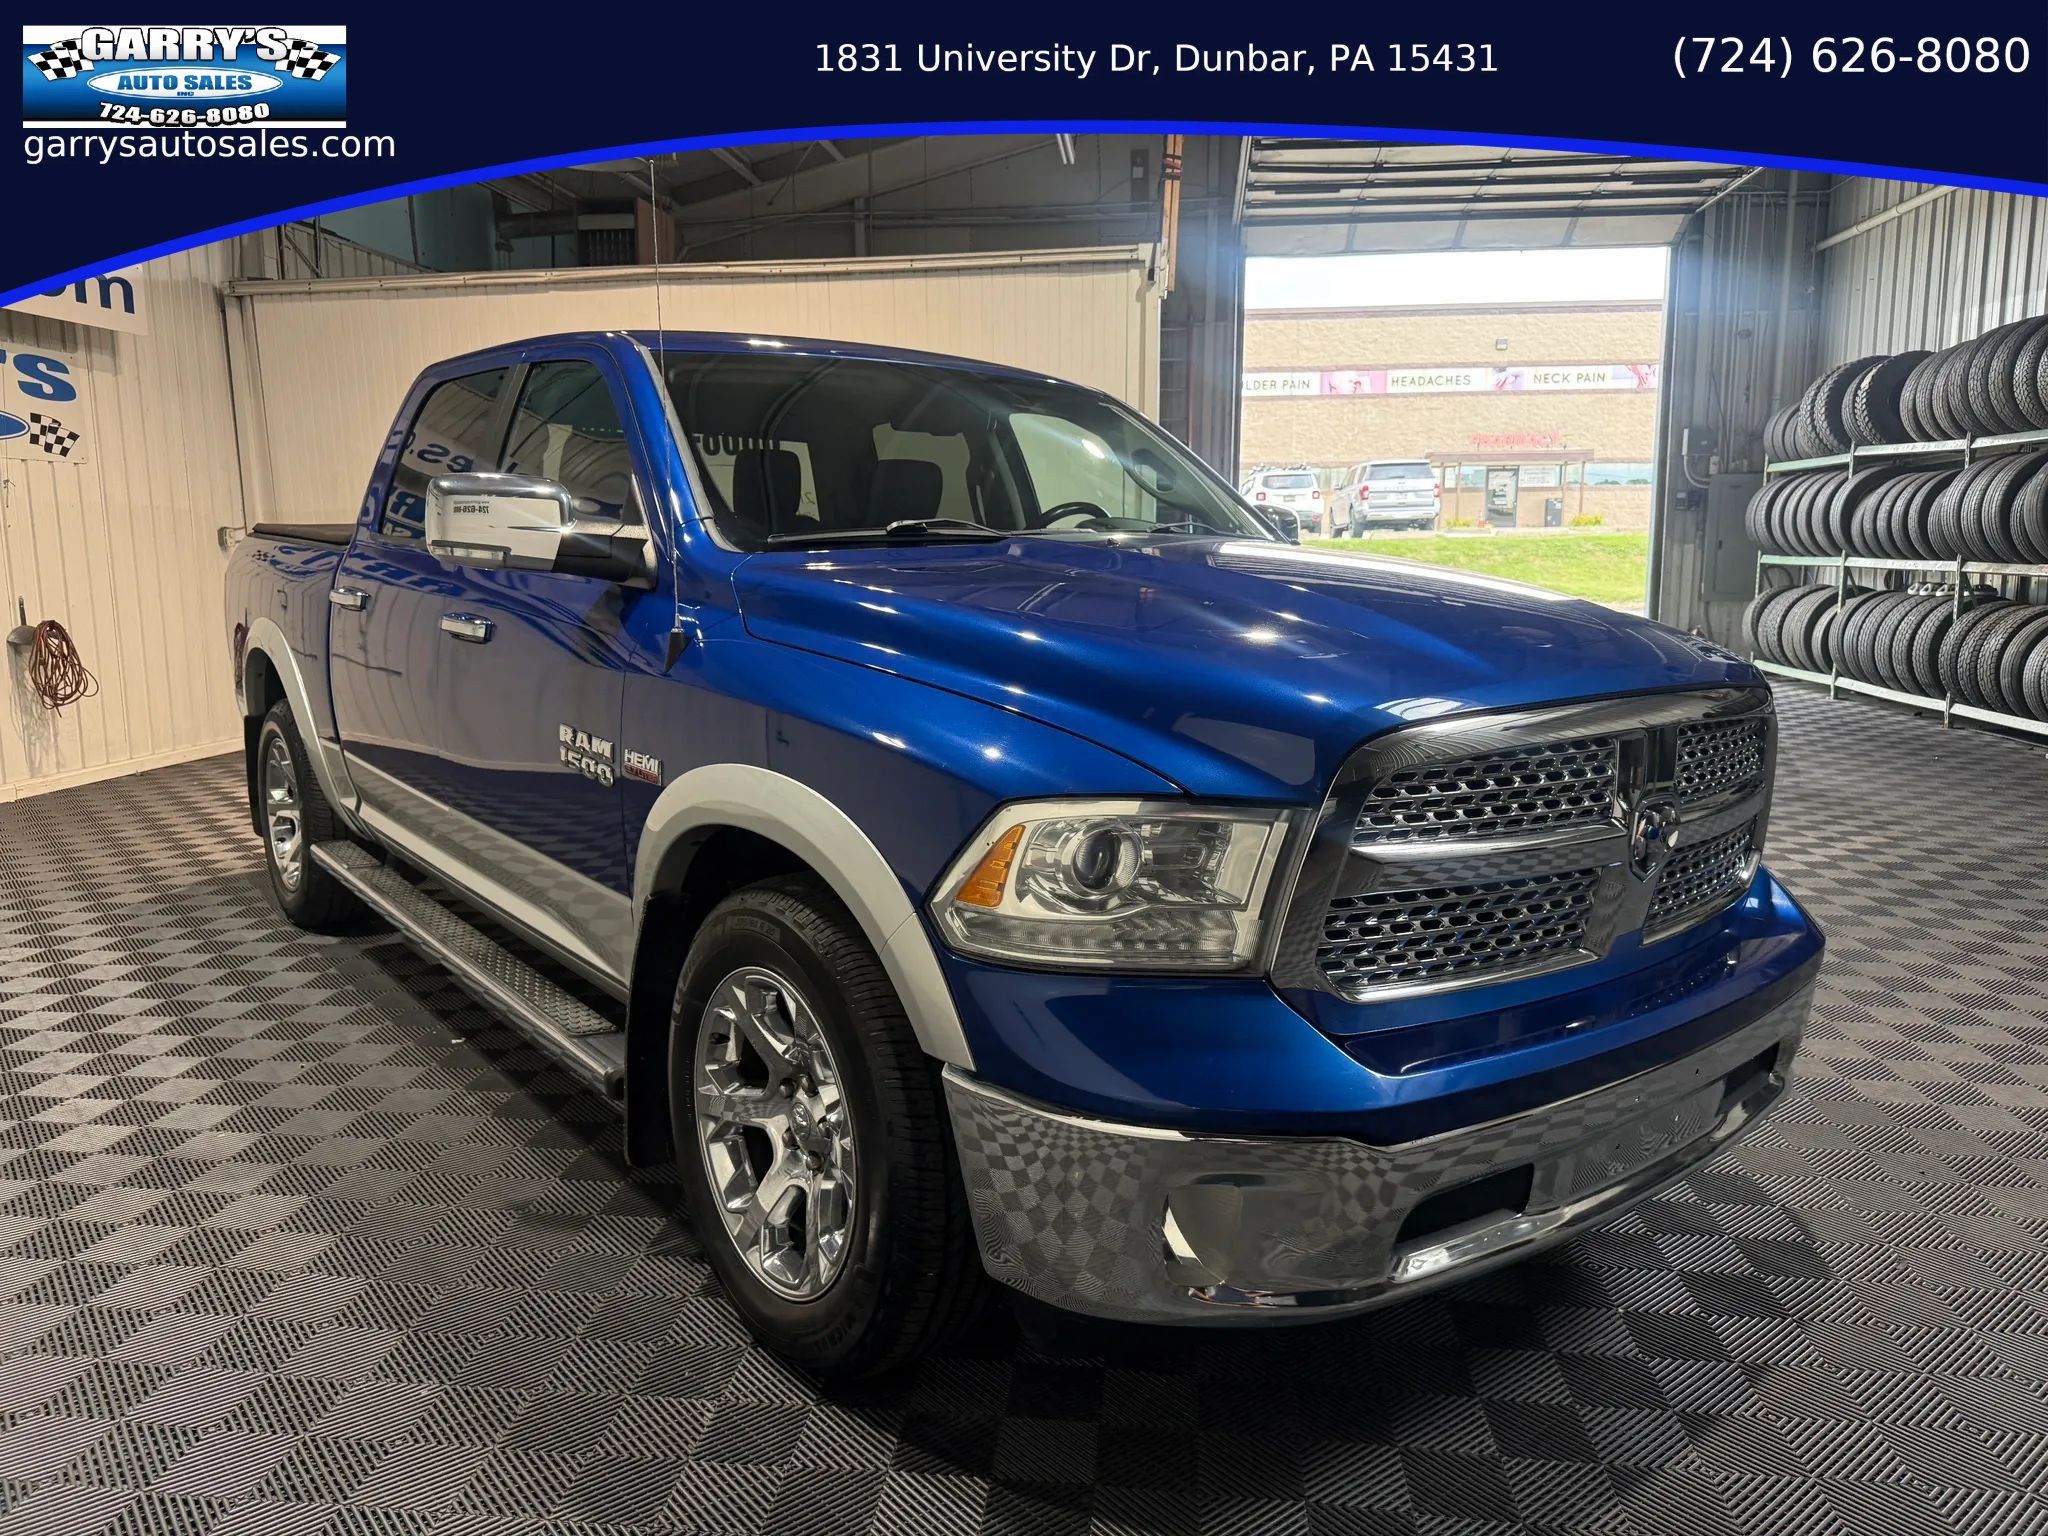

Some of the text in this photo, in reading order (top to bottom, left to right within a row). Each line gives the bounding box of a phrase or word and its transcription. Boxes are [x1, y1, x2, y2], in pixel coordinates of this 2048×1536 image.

[1242, 377, 1310, 391] LDER PAIN
[1391, 374, 1472, 387] HEADACHES
[1533, 372, 1606, 384] NECK PAIN
[559, 722, 614, 763] RAM
[559, 745, 615, 788] 1500
[624, 748, 660, 774] HEMI
